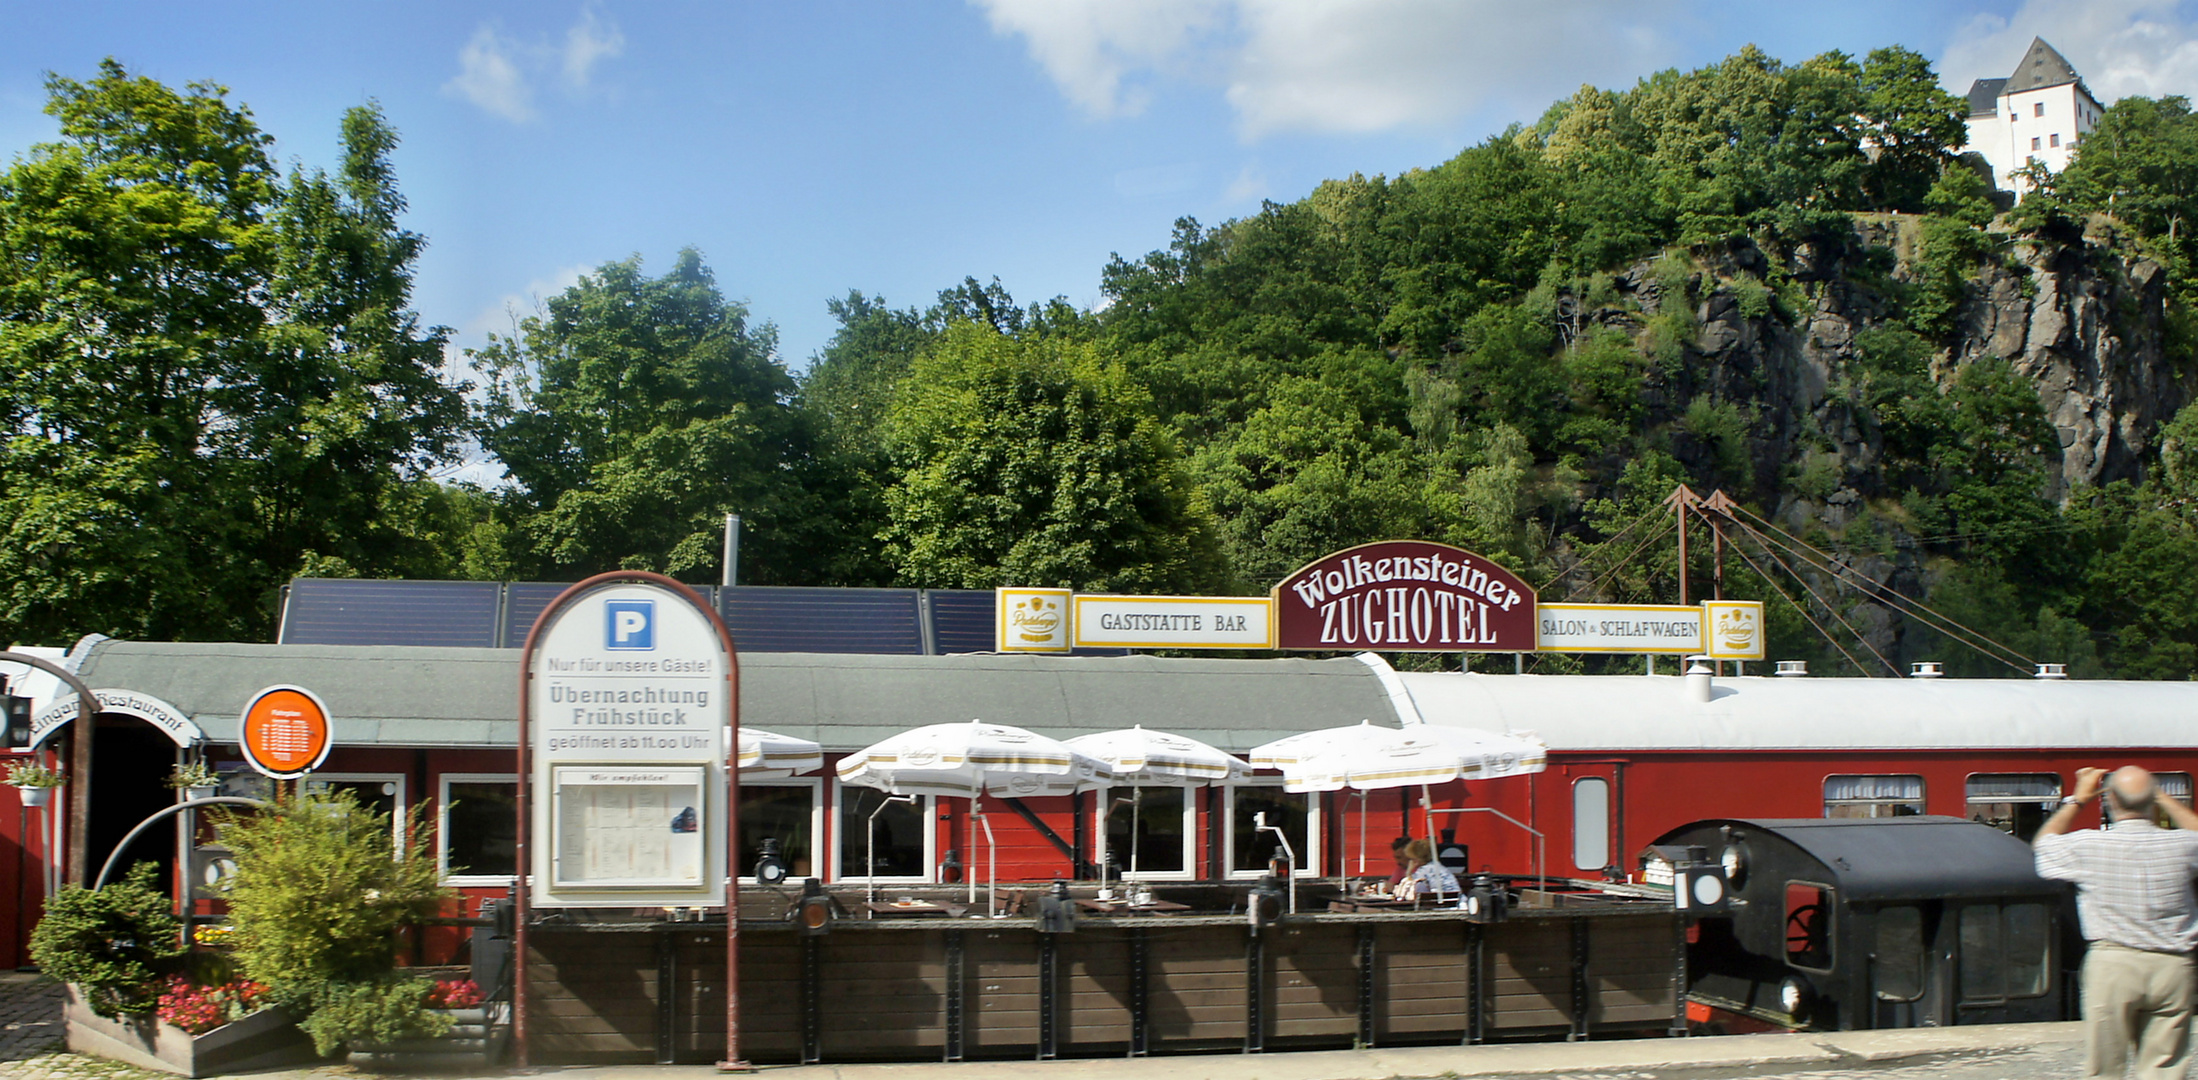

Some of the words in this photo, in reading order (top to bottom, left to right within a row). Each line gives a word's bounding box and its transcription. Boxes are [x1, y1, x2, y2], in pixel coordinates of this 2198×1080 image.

[1292, 553, 1522, 612] Wolkensteiner
[615, 611, 646, 642] P
[1214, 615, 1247, 632] BAR
[1320, 587, 1497, 644] ZUGHOTEL
[1541, 620, 1587, 636] SALON
[548, 658, 575, 672] Nur
[579, 658, 601, 672] für
[605, 661, 657, 672] unsere
[661, 658, 711, 672] Gäste!
[550, 681, 709, 708] Übernachtung
[96, 693, 187, 731] Restaurant
[572, 708, 687, 725] Frühstück
[549, 735, 616, 751] geöffnet
[620, 735, 639, 749] ab
[682, 736, 709, 749] Uhr
